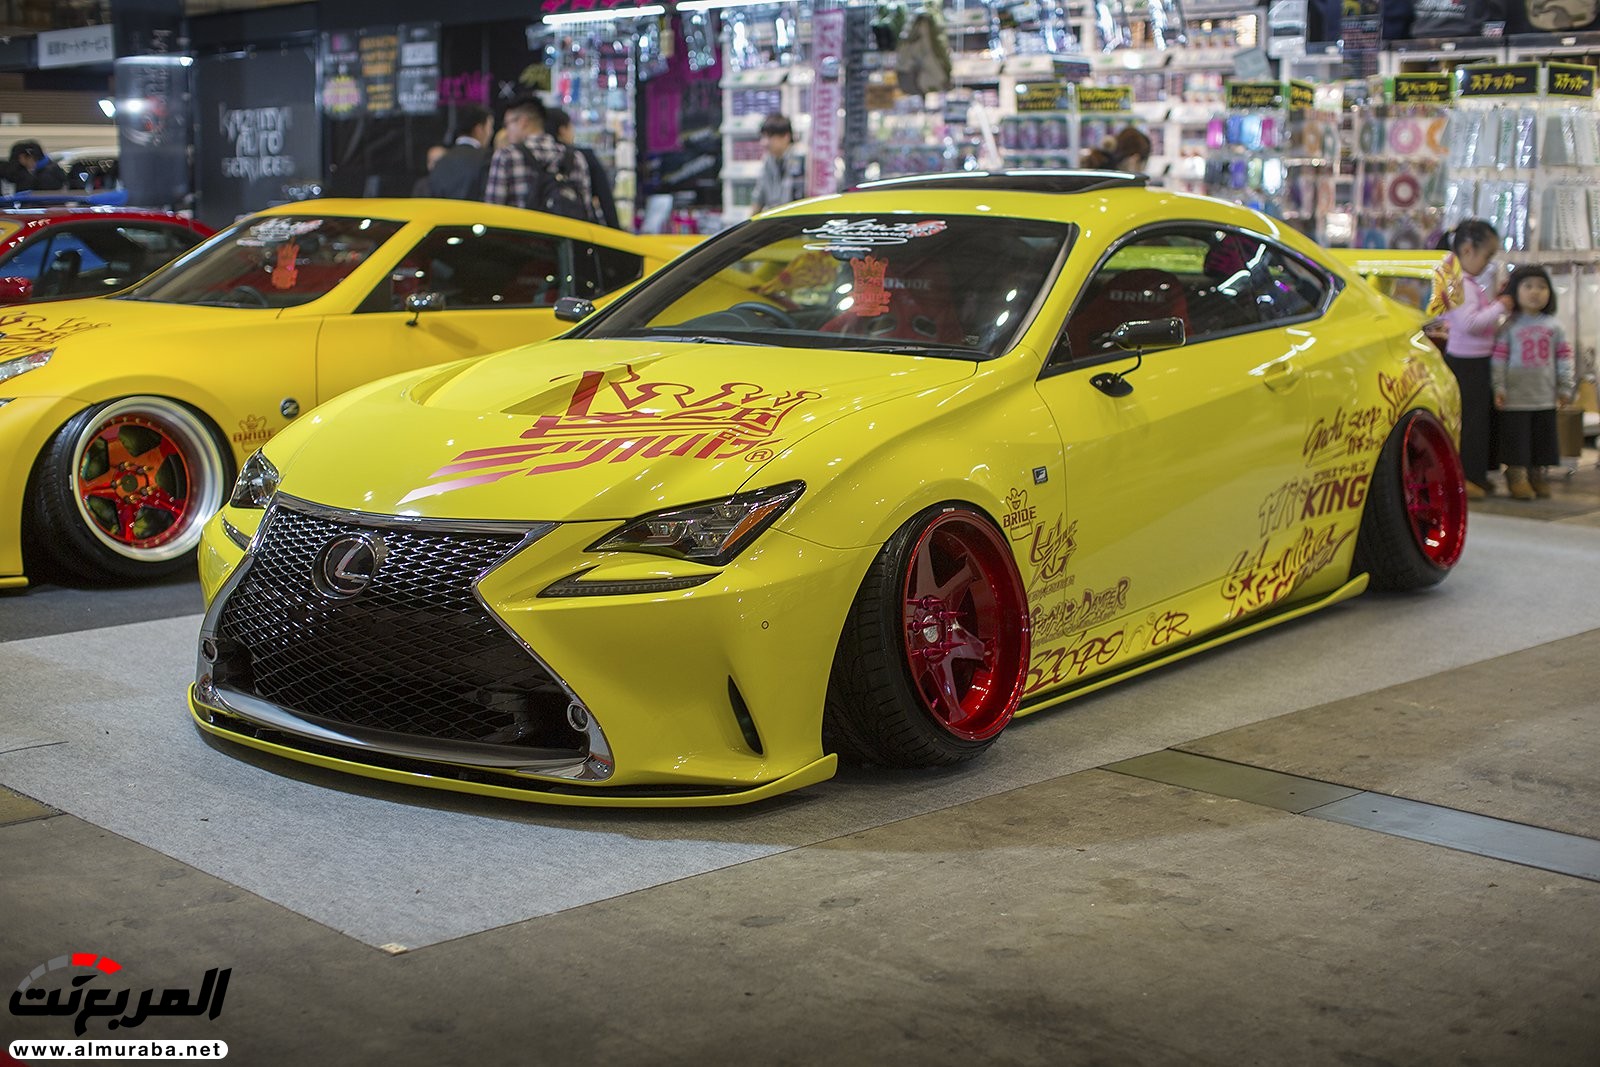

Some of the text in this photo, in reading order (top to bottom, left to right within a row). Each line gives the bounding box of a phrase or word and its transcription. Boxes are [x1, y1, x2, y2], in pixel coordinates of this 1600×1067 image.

[1470, 73, 1527, 91] ステッカー
[1300, 473, 1370, 521] KING
[1002, 505, 1037, 529] BRIDE
